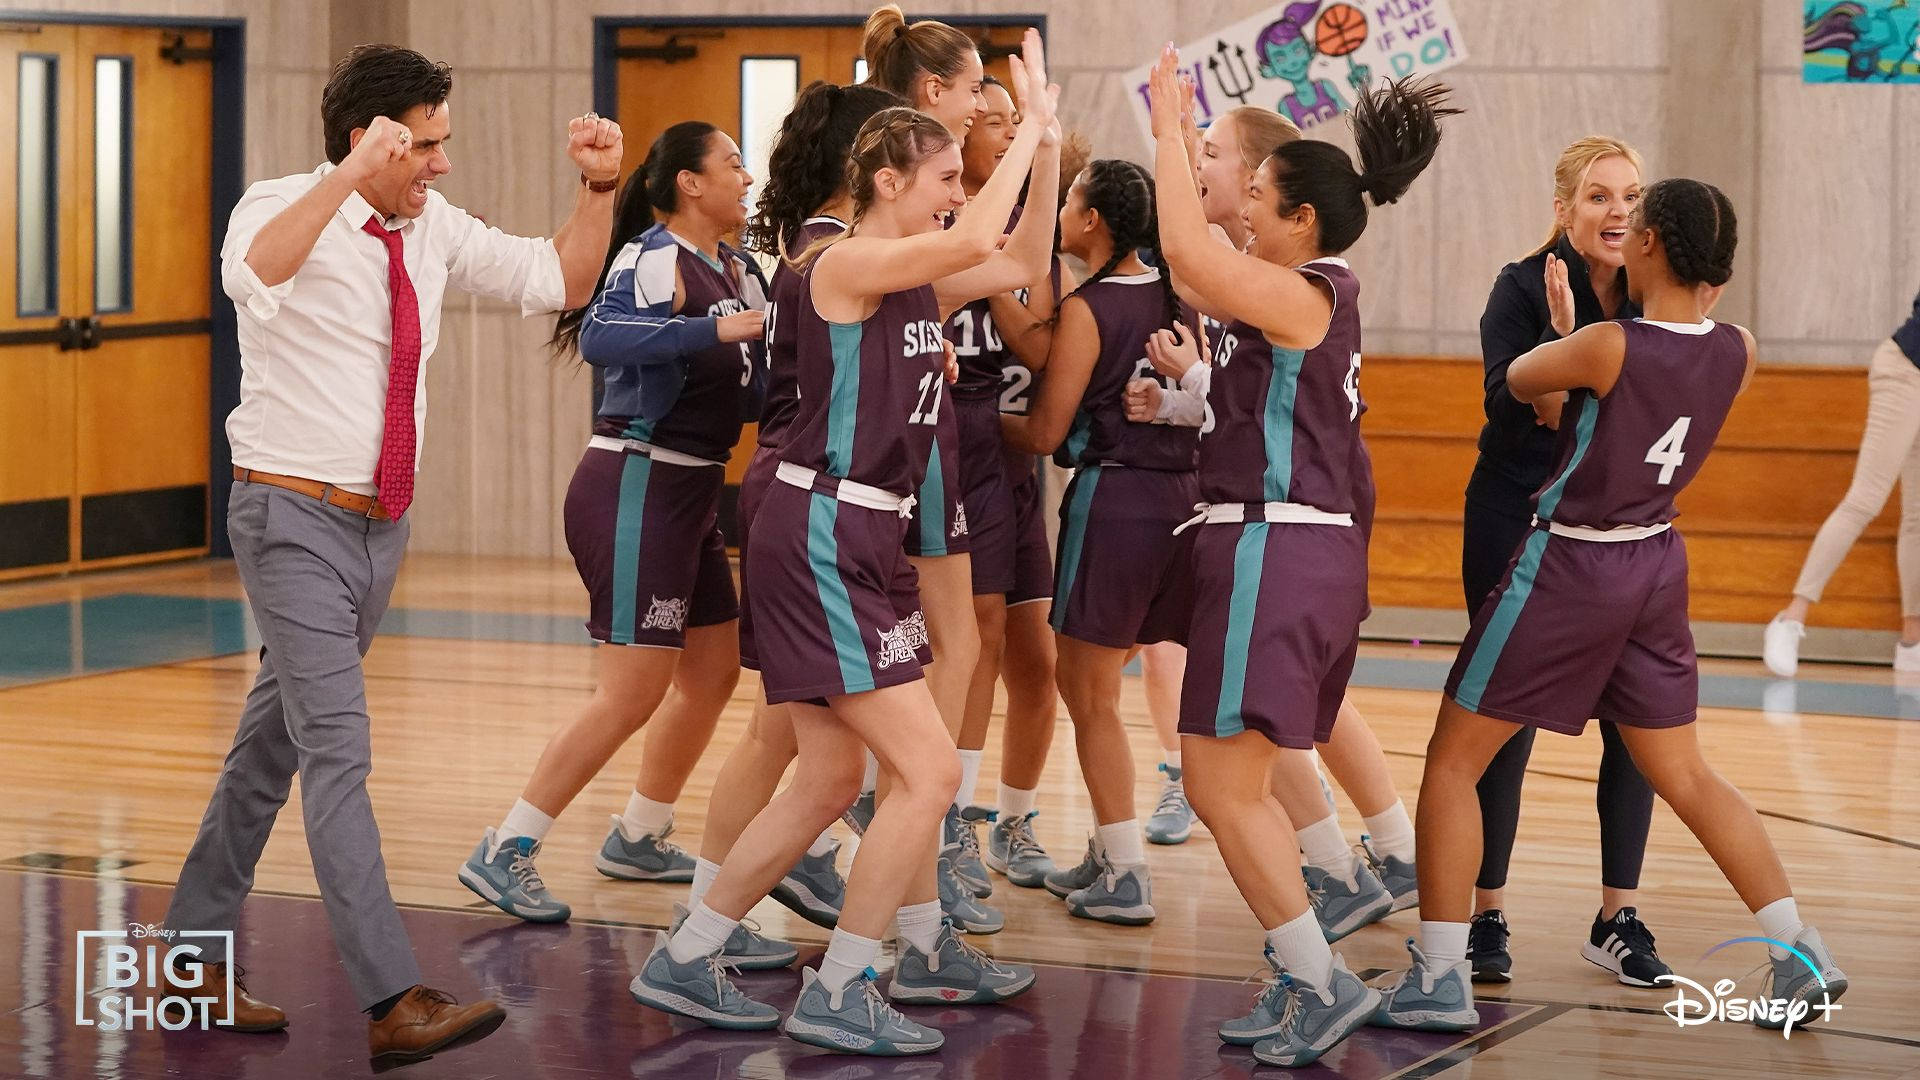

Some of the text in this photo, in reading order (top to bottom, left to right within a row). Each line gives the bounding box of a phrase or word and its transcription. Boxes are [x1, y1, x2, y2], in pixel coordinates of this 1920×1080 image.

[1376, 11, 1437, 51] IF WE
[739, 341, 753, 388] 5
[908, 371, 944, 426] 11
[998, 365, 1032, 412] 2
[1643, 416, 1692, 486] 4
